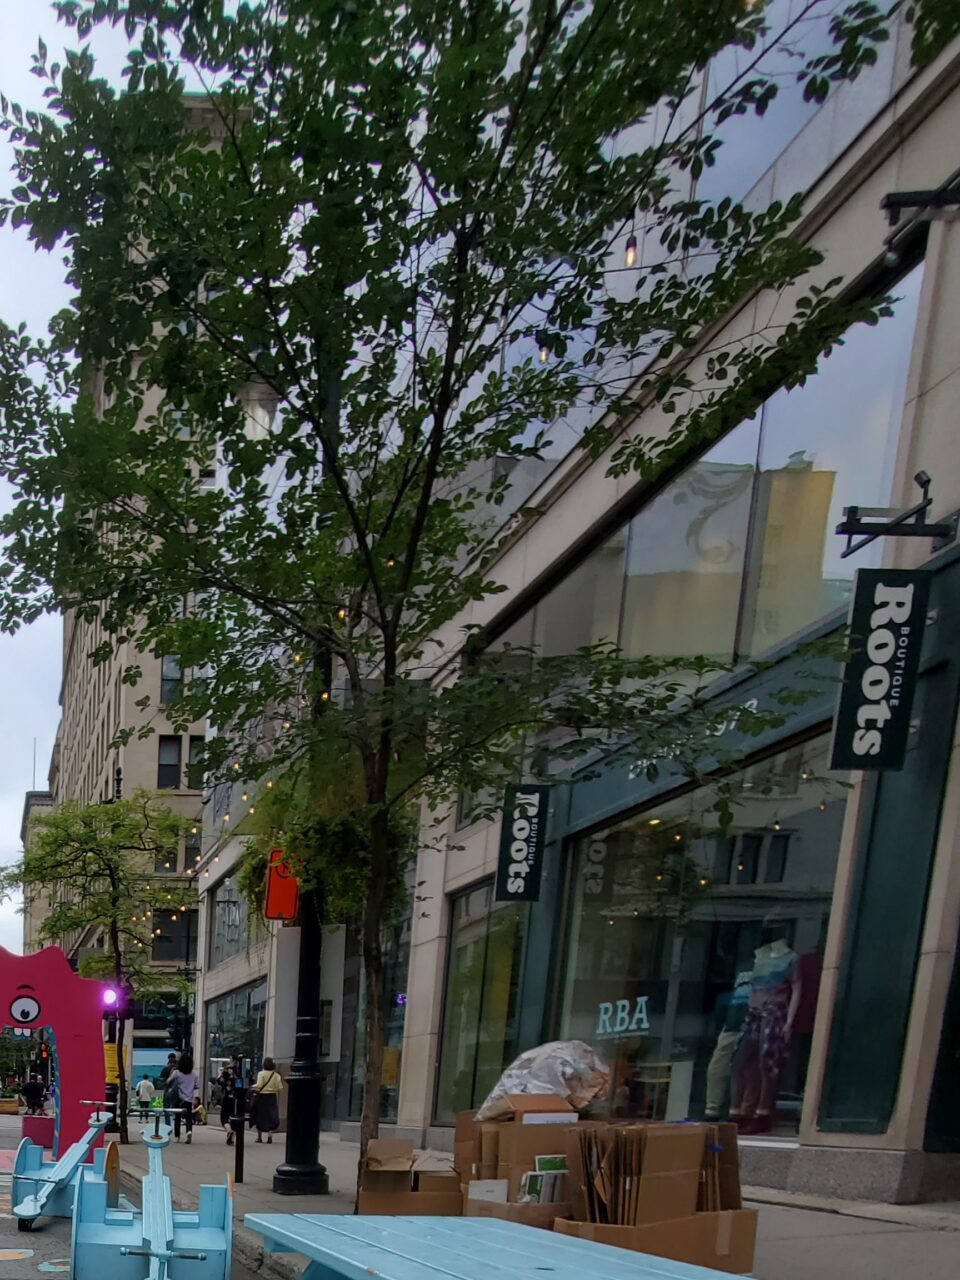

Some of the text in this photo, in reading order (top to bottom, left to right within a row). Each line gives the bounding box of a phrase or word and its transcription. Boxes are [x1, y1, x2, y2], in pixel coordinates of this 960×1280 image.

[852, 582, 915, 756] Roots
[890, 626, 911, 707] BOUTIQUE
[507, 792, 540, 893] Roots
[527, 818, 539, 865] BOUTIQUE
[596, 996, 650, 1034] RBA
